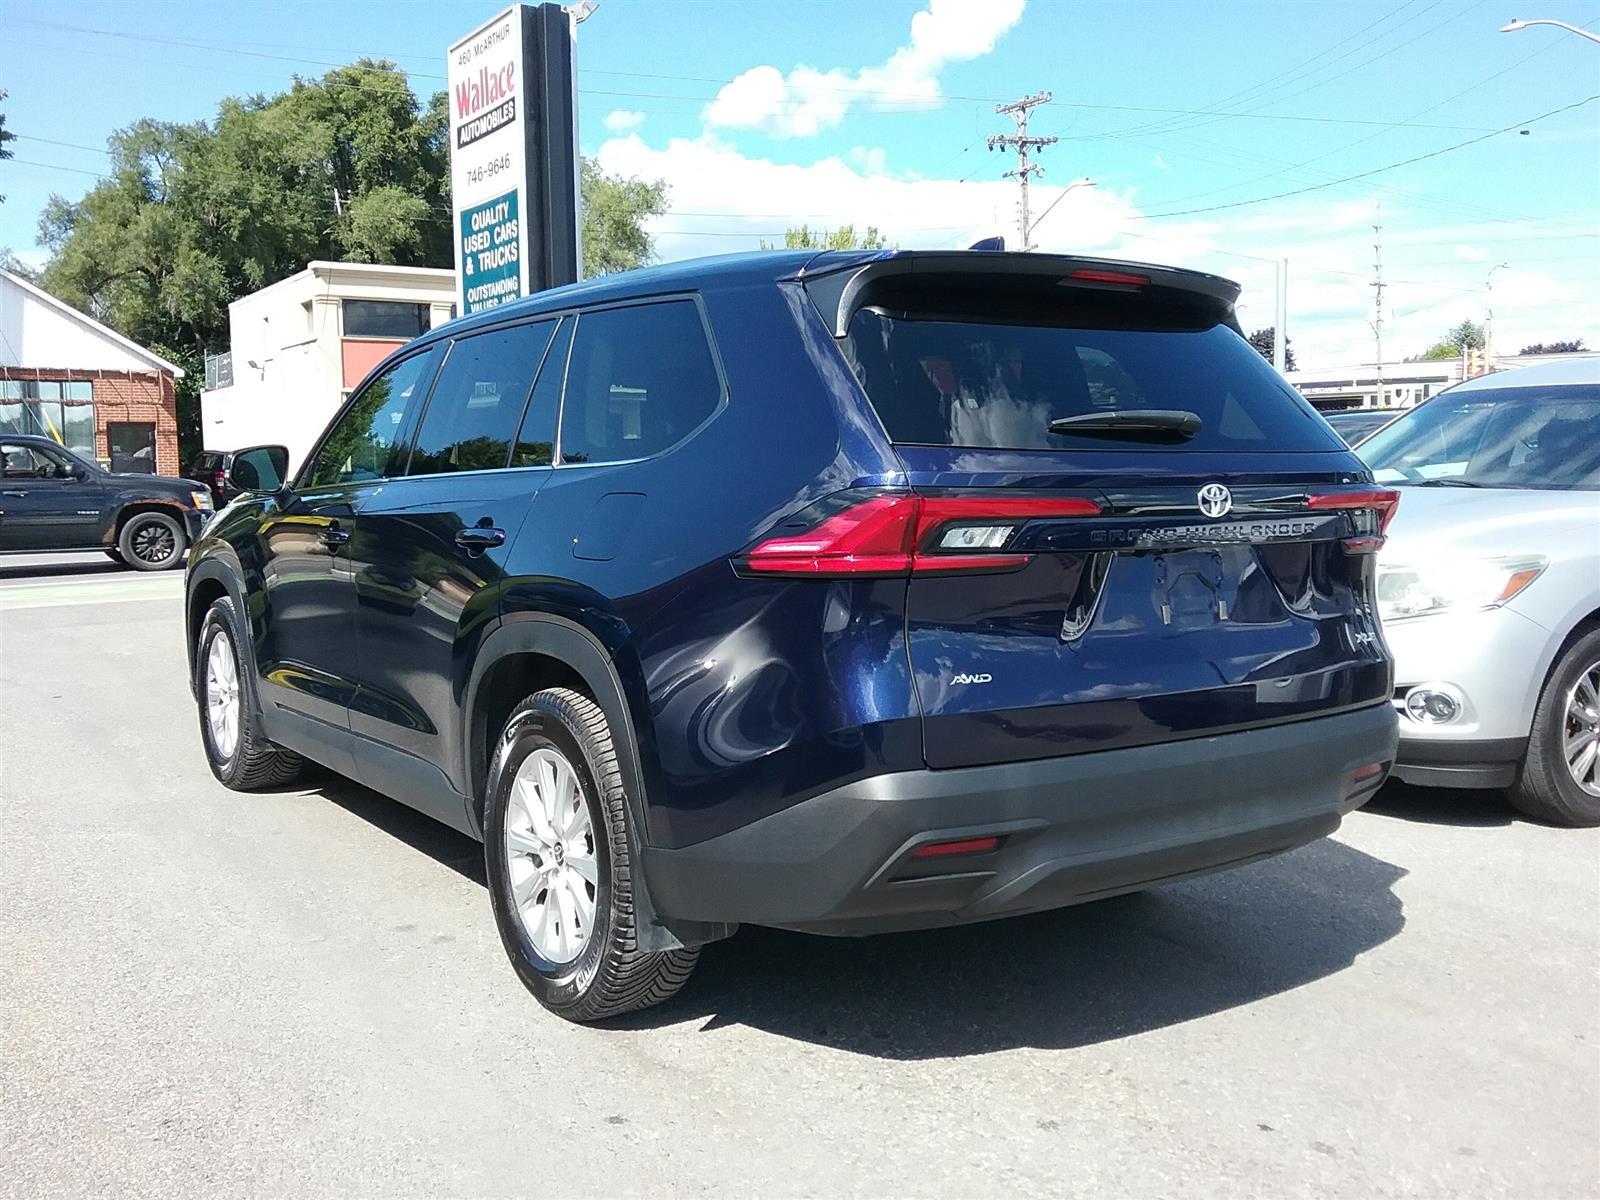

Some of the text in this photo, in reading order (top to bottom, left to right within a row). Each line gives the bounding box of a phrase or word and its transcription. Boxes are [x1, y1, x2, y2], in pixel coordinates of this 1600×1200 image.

[458, 24, 510, 65] 460 McARTHUR
[456, 61, 515, 119] Wallace
[459, 100, 514, 145] AUTOMOBILES
[467, 153, 511, 186] 746-9646
[472, 201, 509, 231] QUALITY
[464, 219, 518, 254] USED CARS
[465, 242, 518, 275] & TRUCKS
[467, 275, 518, 303] OUTSTANDING
[949, 673, 993, 686] AWD
